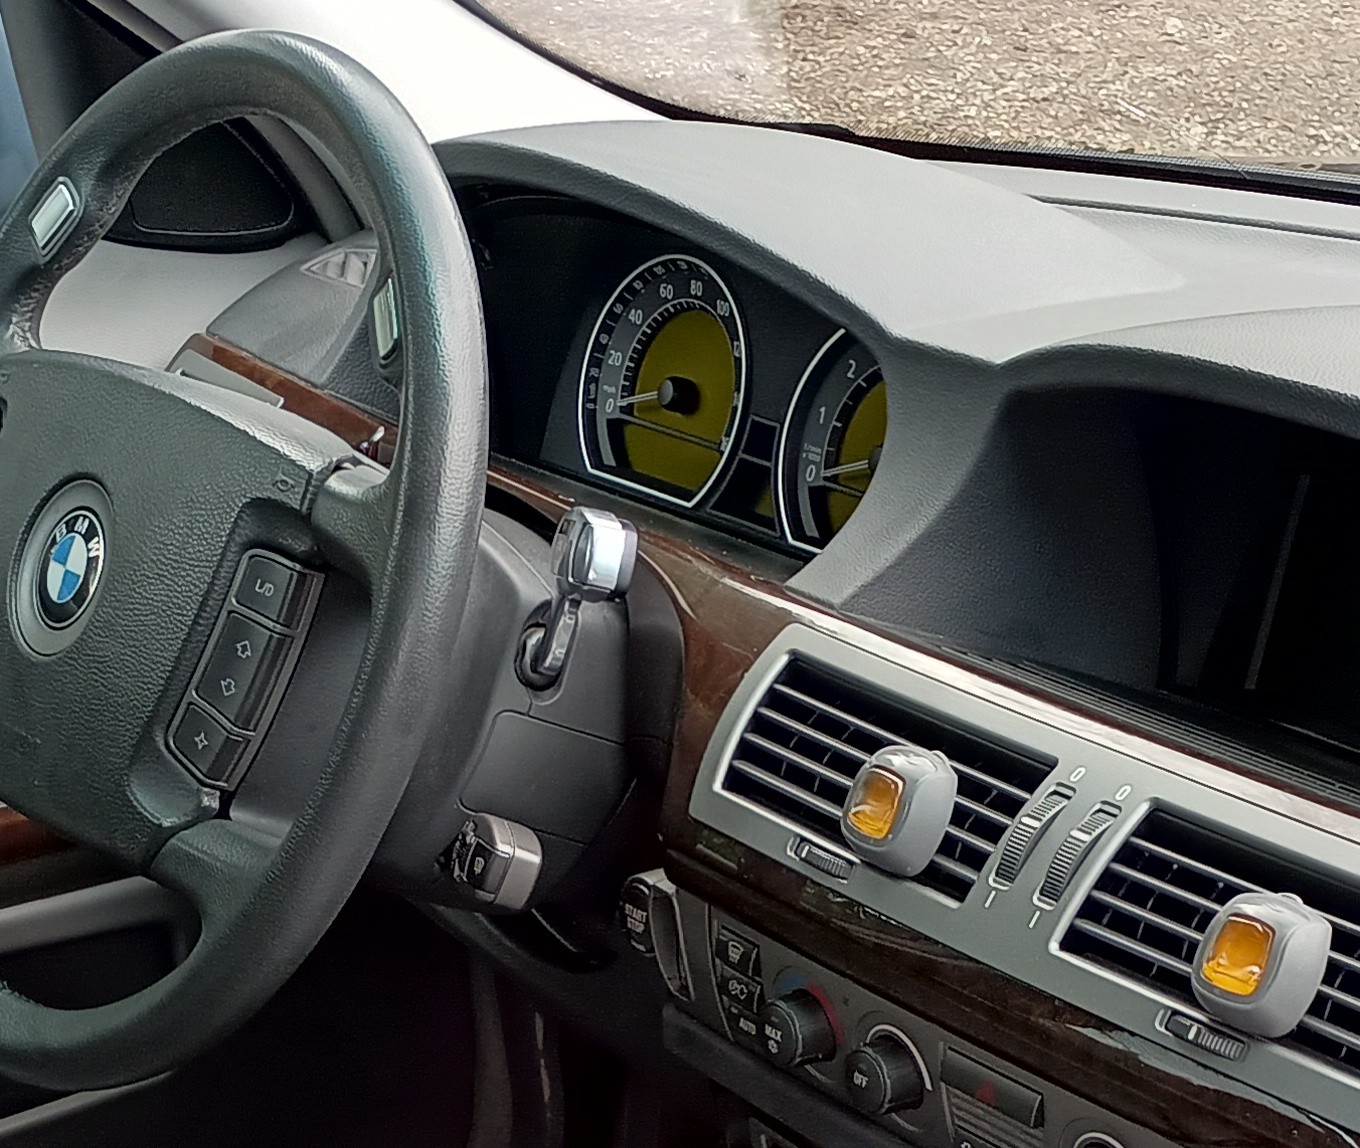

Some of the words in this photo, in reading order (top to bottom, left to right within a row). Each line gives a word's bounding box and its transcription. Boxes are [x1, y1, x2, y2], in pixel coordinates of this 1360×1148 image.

[659, 283, 674, 300] 60
[690, 279, 703, 296] 80
[628, 308, 643, 325] 40
[608, 350, 623, 366] 20
[846, 359, 857, 379] 2
[605, 398, 614, 413] 0
[819, 406, 826, 424] 1
[805, 464, 816, 482] 0
[55, 516, 100, 557] BMW
[625, 903, 647, 923] START
[627, 916, 645, 934] STOP
[739, 1018, 756, 1035] AUTO
[765, 1024, 782, 1042] MAX
[854, 1071, 869, 1088] OFF
